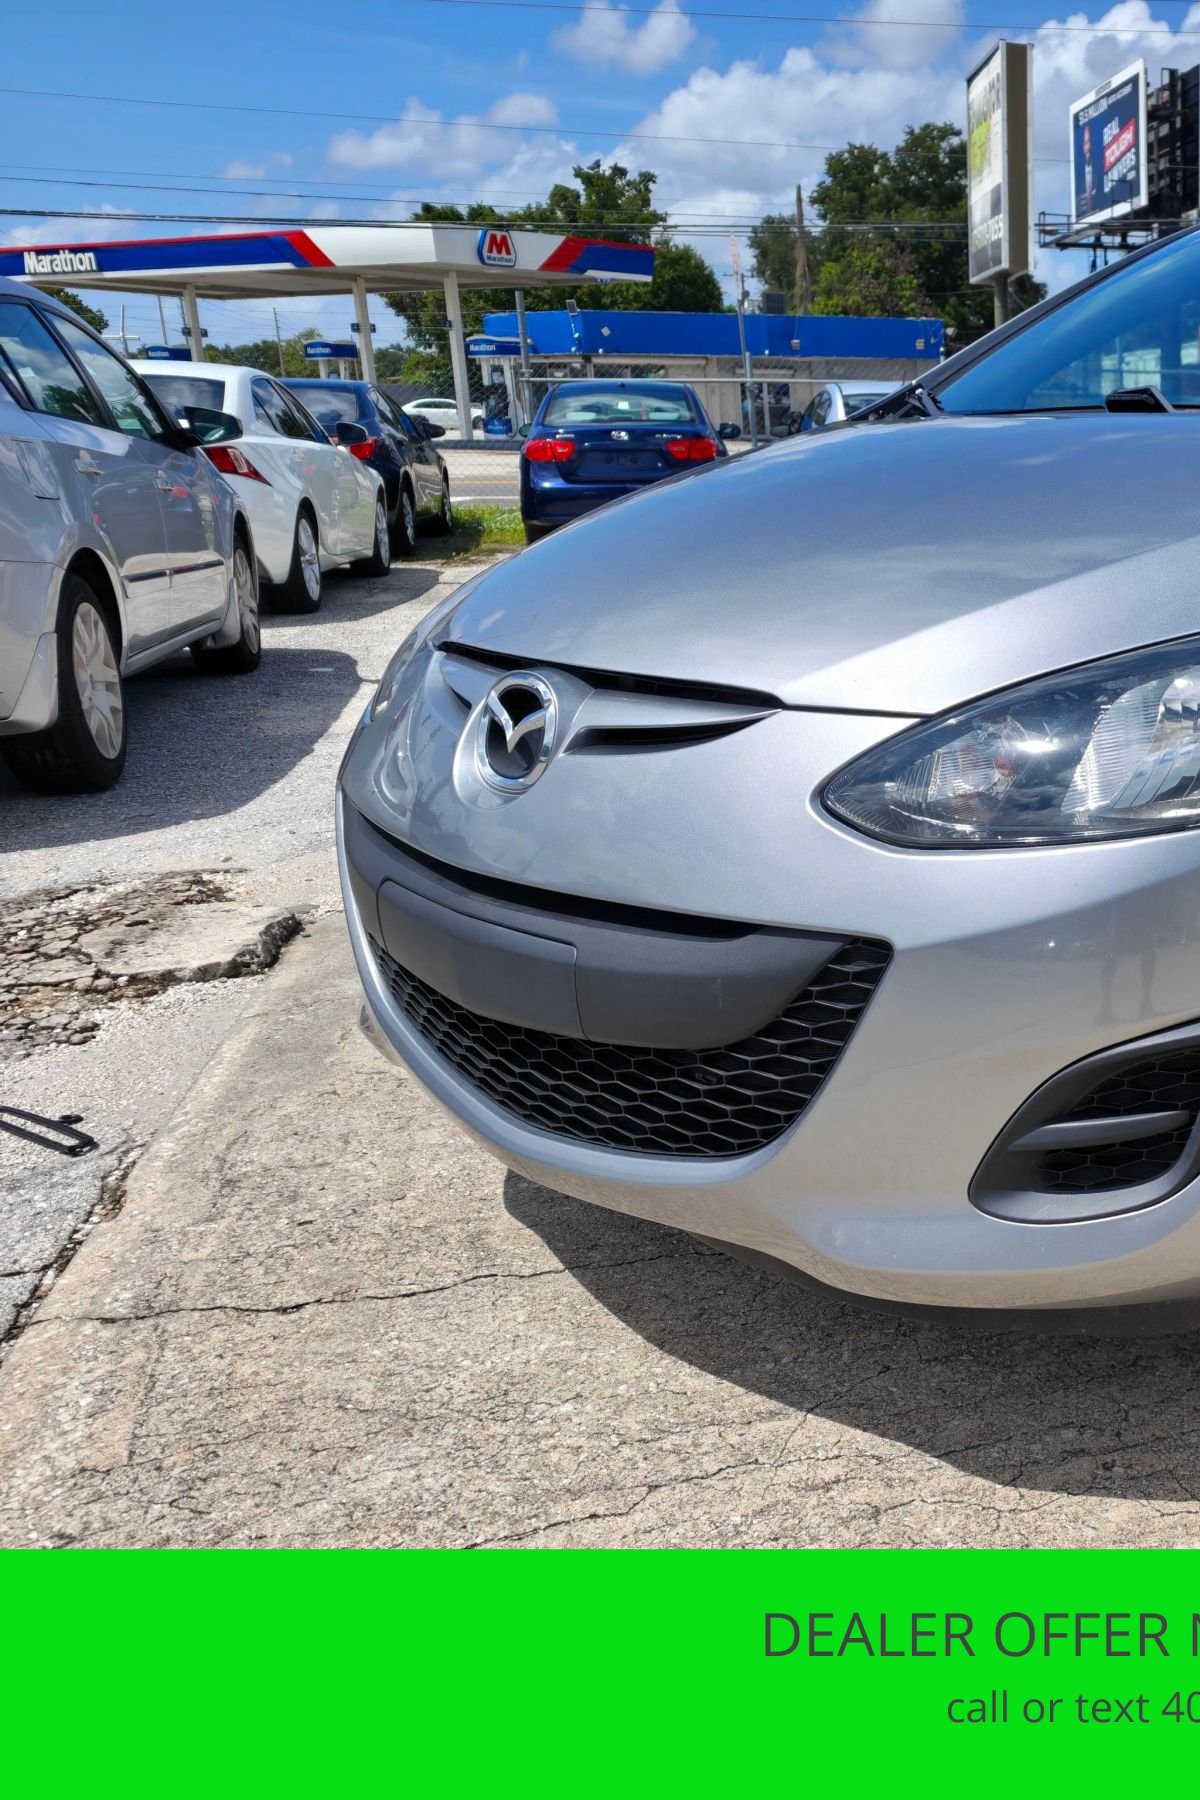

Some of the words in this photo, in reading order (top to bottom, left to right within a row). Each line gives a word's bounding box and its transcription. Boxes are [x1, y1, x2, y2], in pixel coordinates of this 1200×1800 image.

[487, 233, 512, 256] M
[24, 249, 97, 274] Marathon
[470, 343, 496, 352] Marathon
